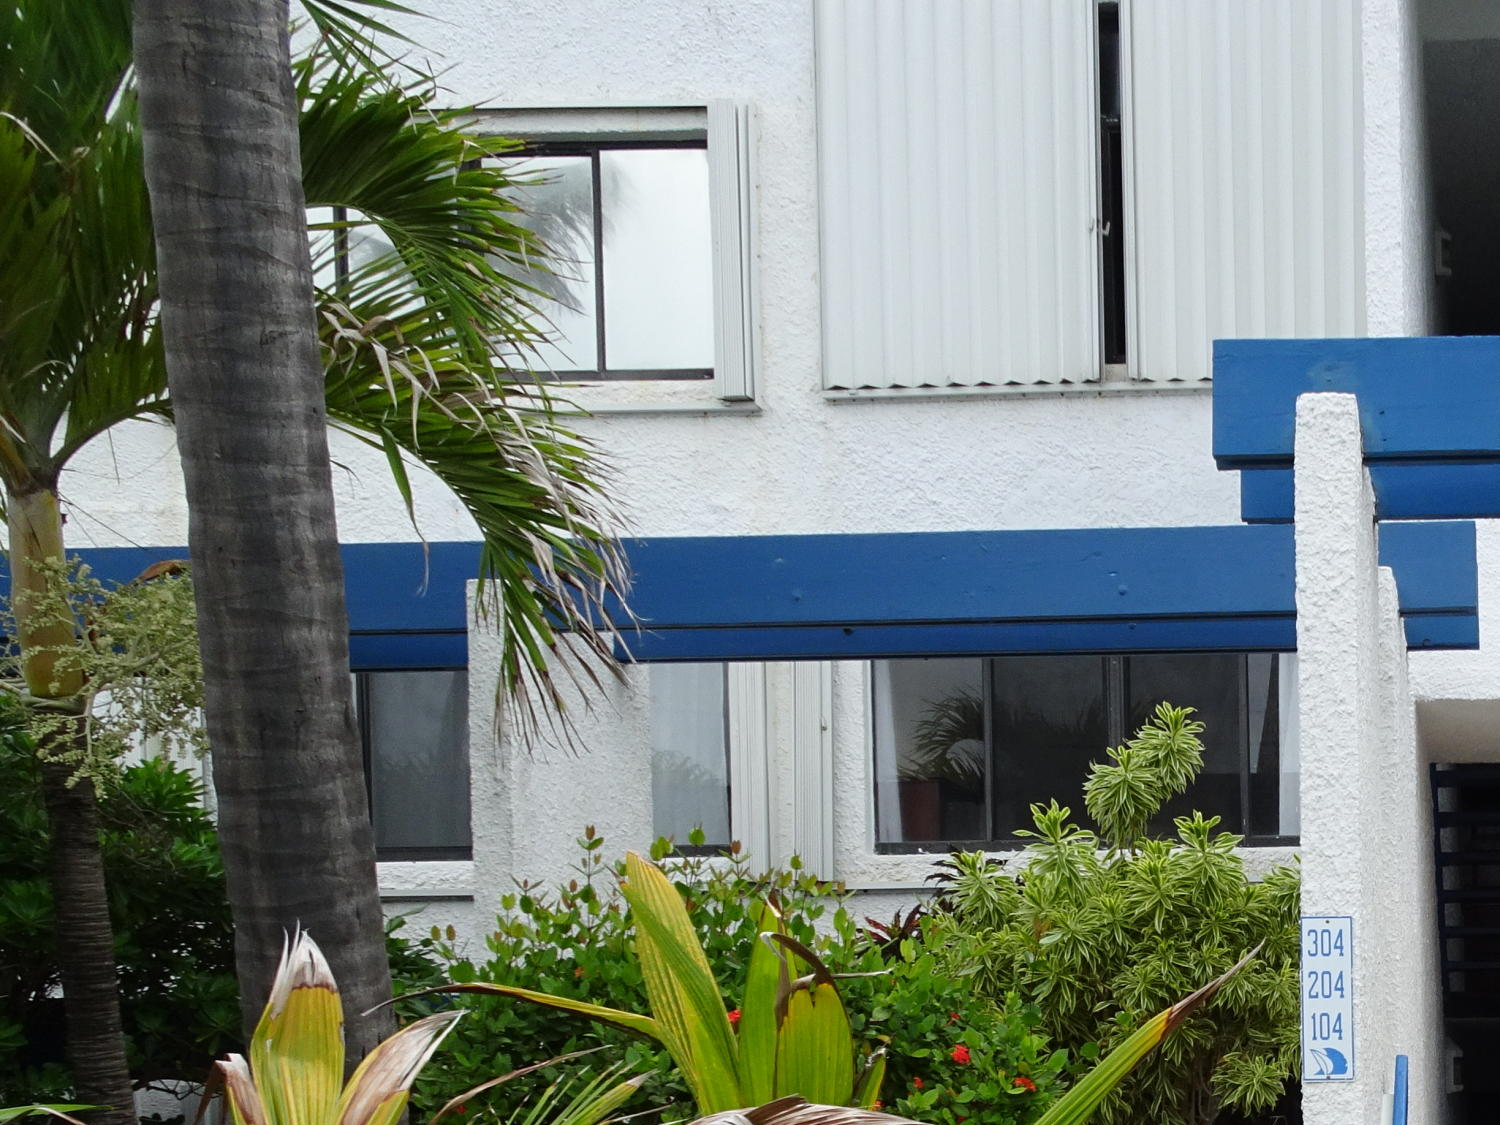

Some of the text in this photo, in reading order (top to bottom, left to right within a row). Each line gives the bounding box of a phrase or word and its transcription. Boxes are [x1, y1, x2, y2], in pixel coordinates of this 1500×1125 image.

[1307, 929, 1344, 957] 304
[1308, 971, 1345, 999] 204
[1311, 1012, 1343, 1040] 104
